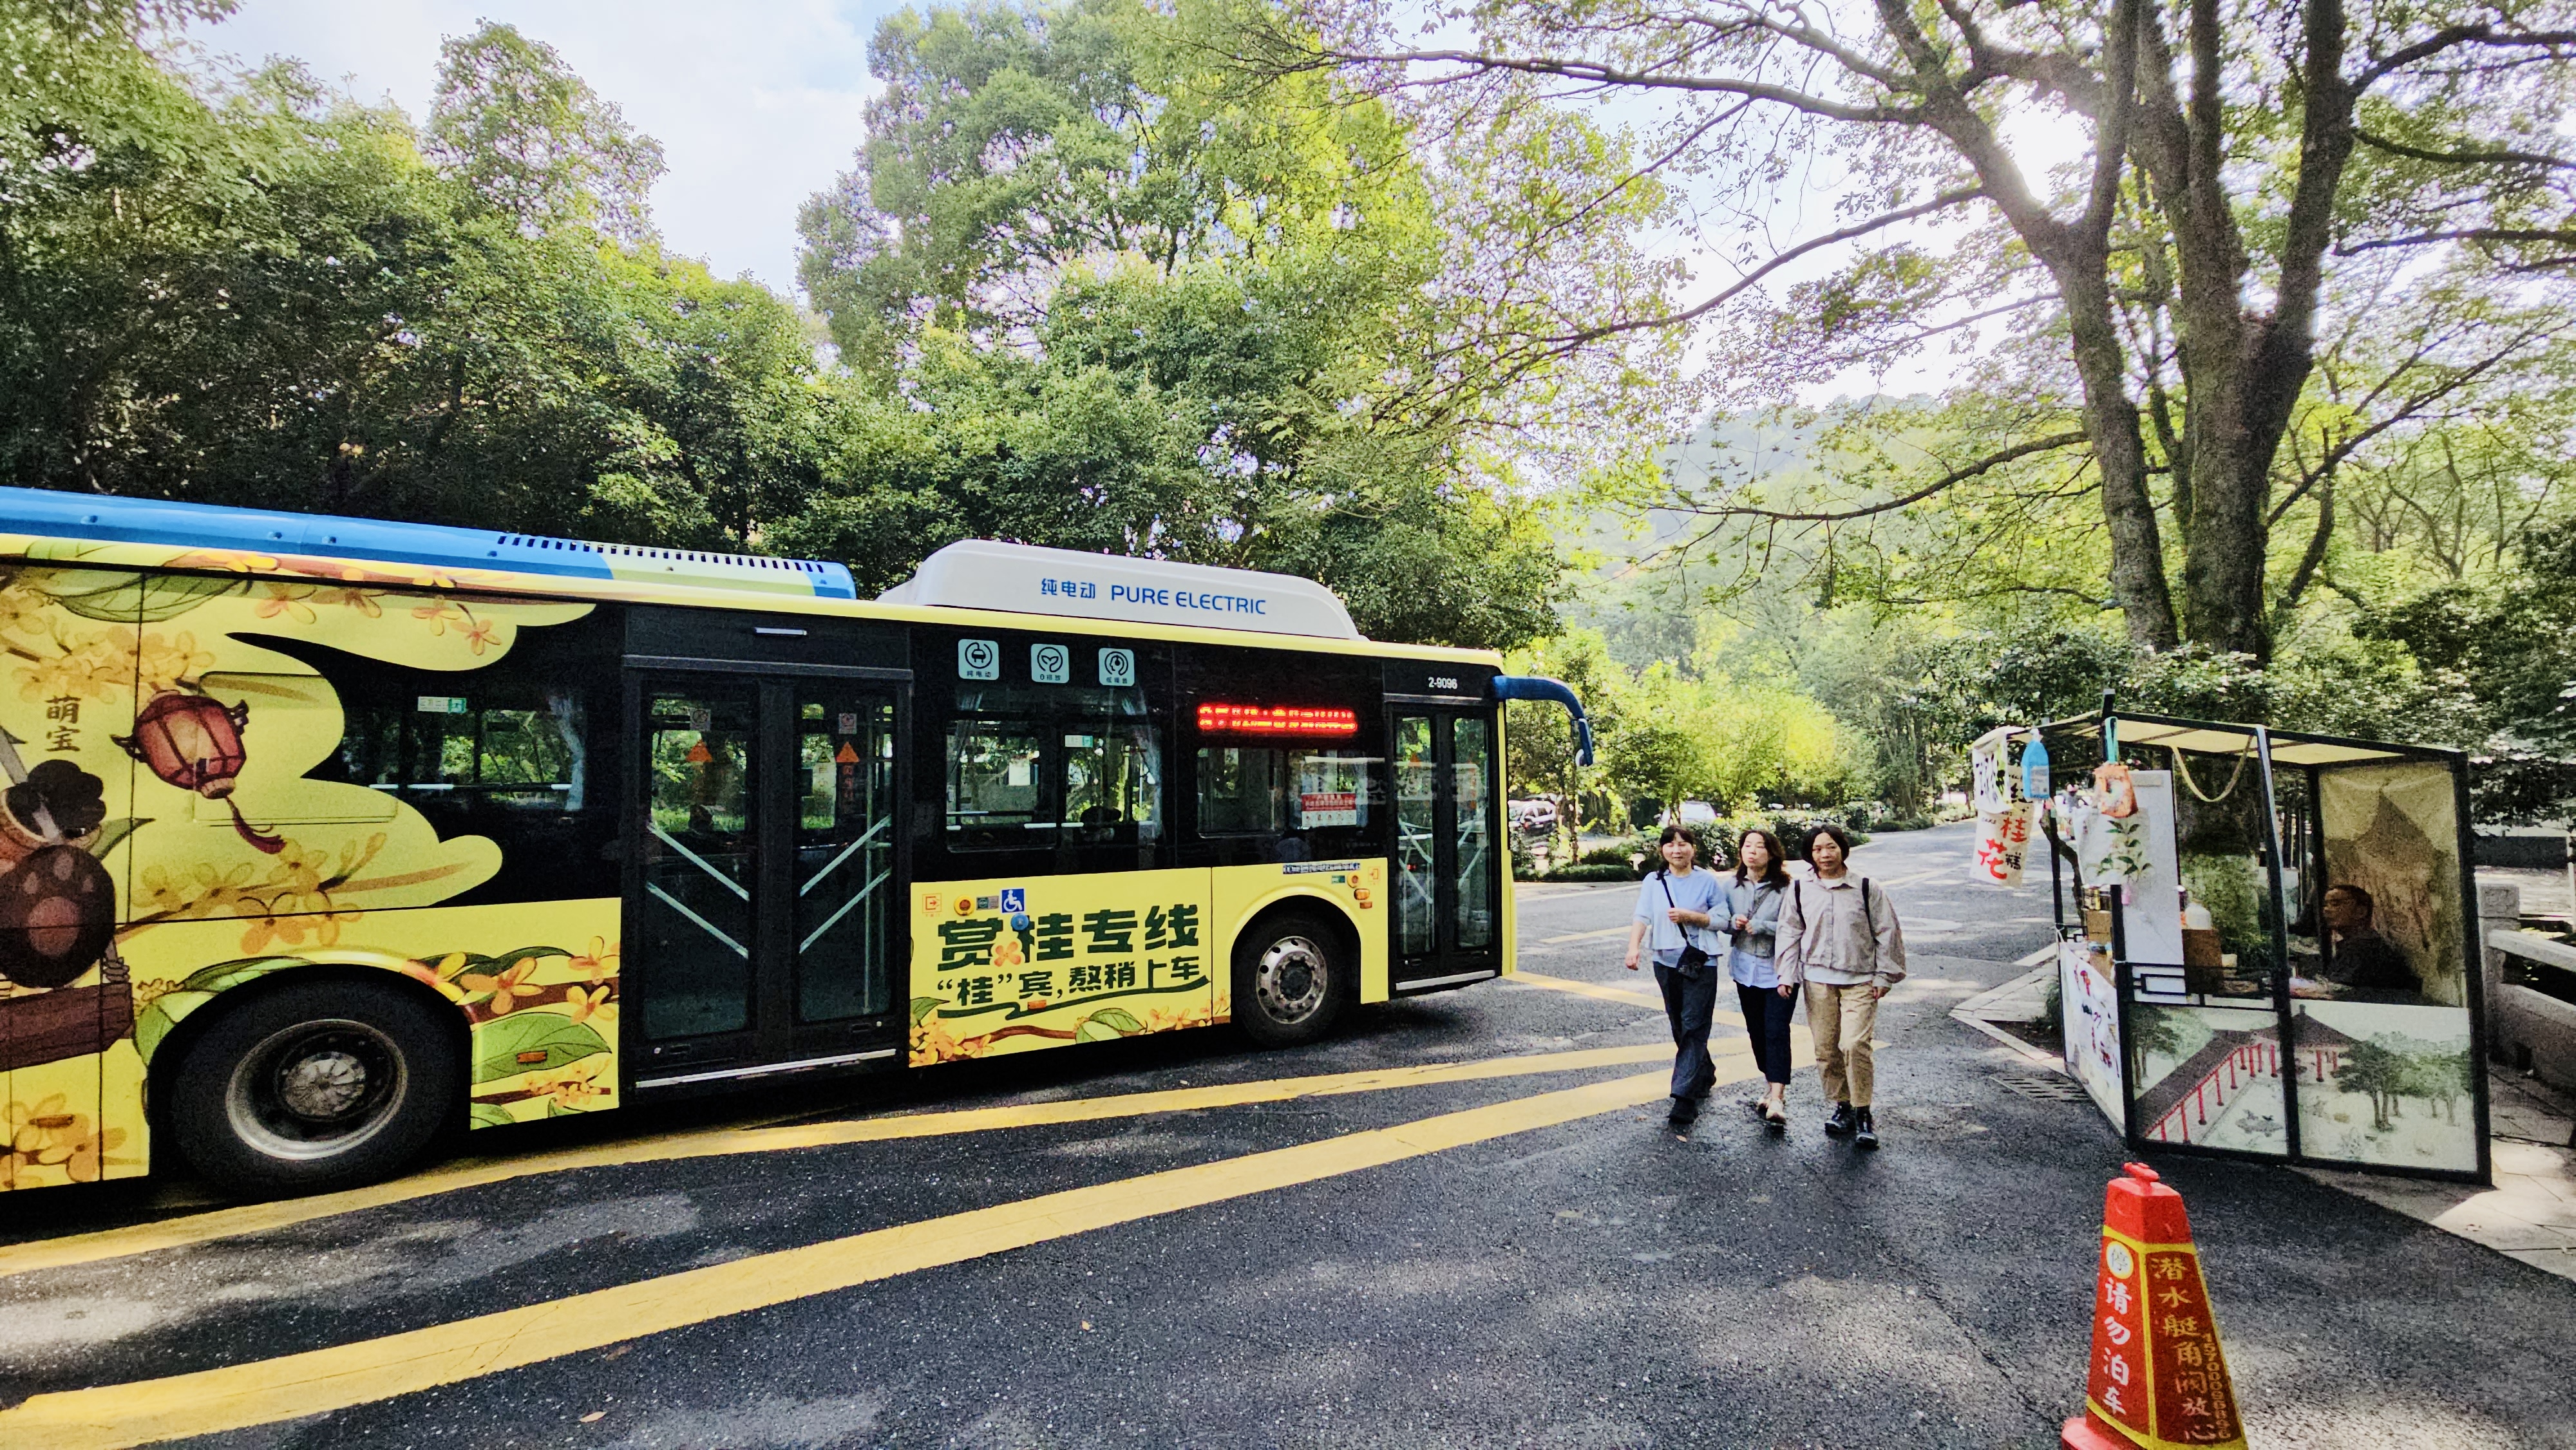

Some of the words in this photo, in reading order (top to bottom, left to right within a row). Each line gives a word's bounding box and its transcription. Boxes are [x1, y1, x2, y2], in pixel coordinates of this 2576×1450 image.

[1041, 578, 1096, 600] 纯电动
[1111, 585, 1169, 606] PURE
[1175, 592, 1267, 616] ELECTRIC
[1428, 676, 1458, 691] 2-9096
[45, 694, 80, 753] 萌宝
[937, 903, 1200, 971] 赏桂专线
[2103, 1277, 2132, 1415] 请勿泊车
